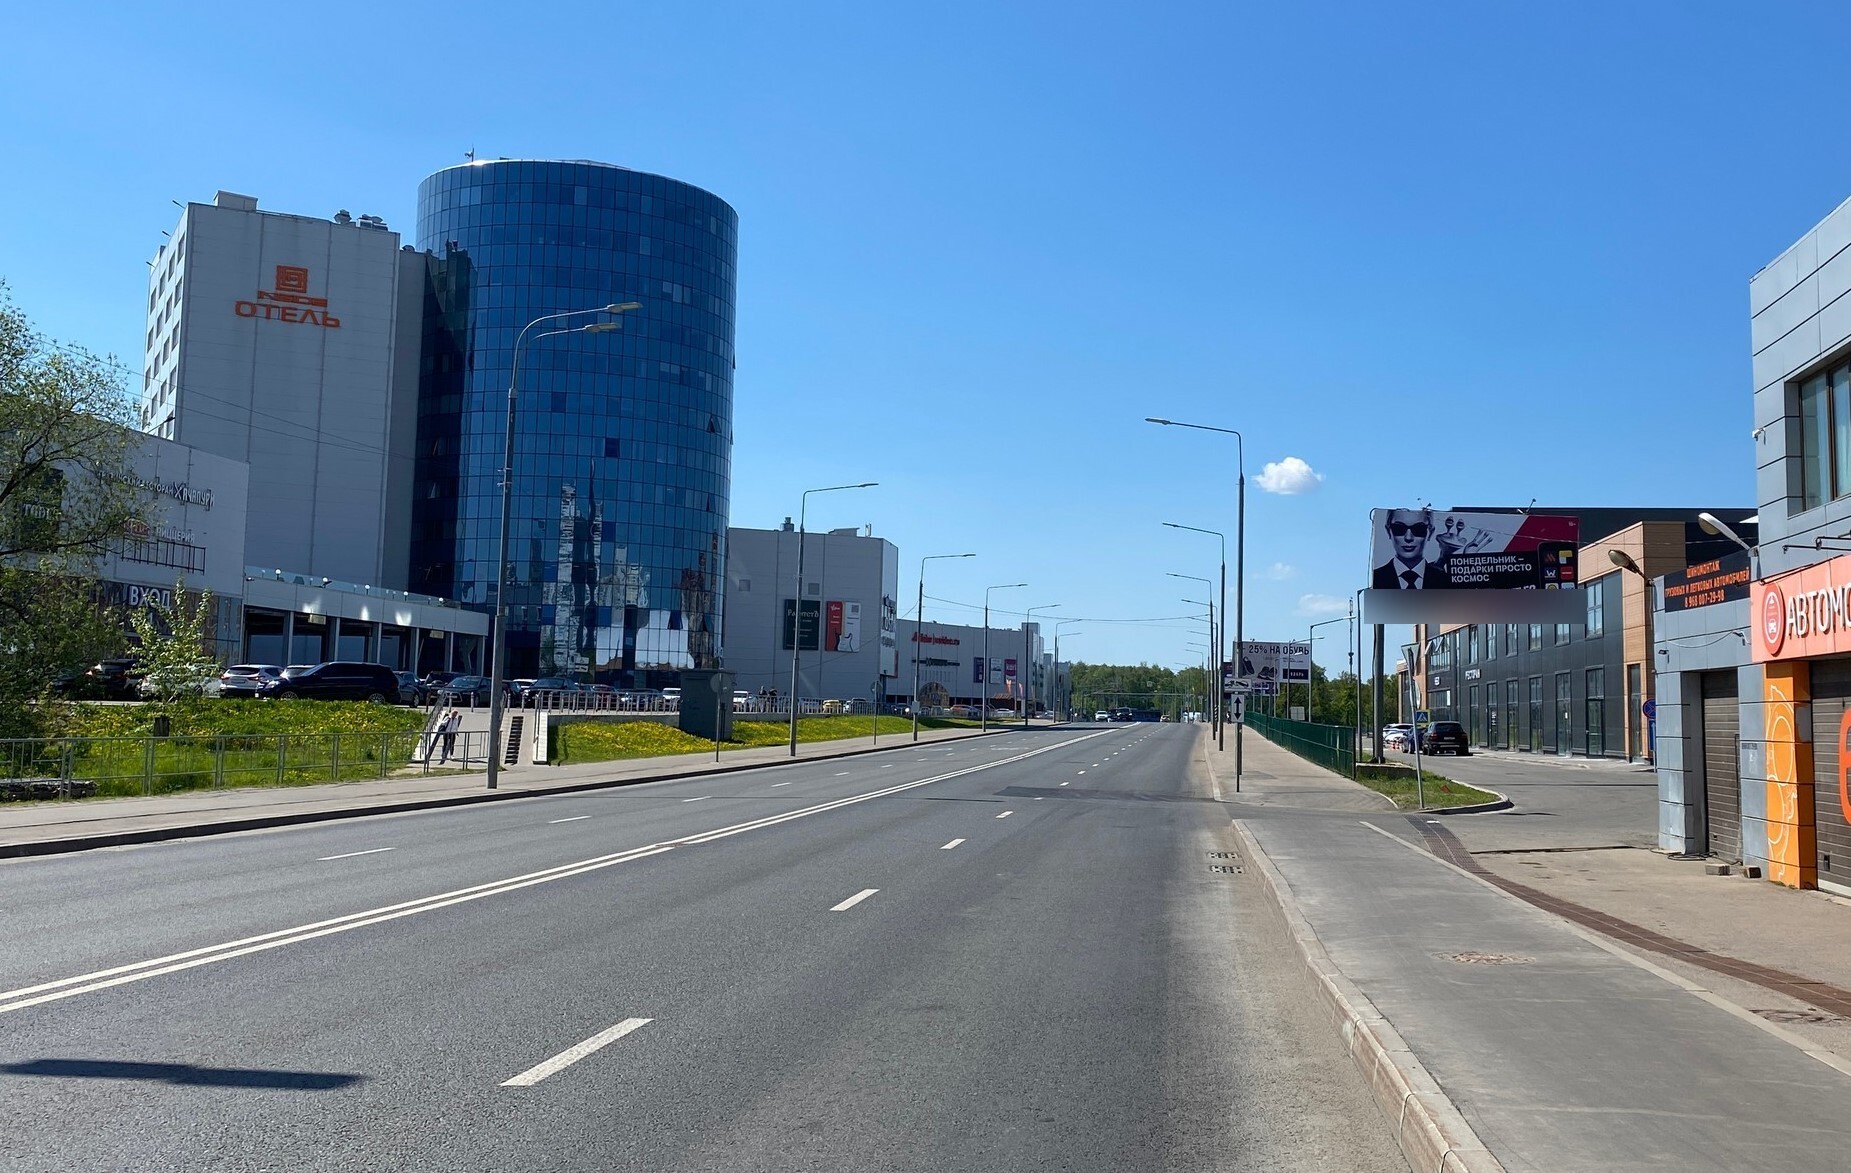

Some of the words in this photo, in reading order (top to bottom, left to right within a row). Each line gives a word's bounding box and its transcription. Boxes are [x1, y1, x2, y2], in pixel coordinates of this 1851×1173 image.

[235, 300, 341, 327] ОТЕЛЬ
[156, 526, 196, 543] ПИЦЦЕРИЯ
[1450, 556, 1517, 566] ПОНЕДЕЛЬНИК
[1451, 565, 1494, 575] ПОДАРКИ
[1495, 563, 1532, 573] ПРОСТО
[1451, 574, 1490, 583] КОСМОС
[129, 585, 171, 611] ВХОД
[1269, 646, 1281, 655] НА
[1282, 646, 1310, 656] ОБУВЬ
